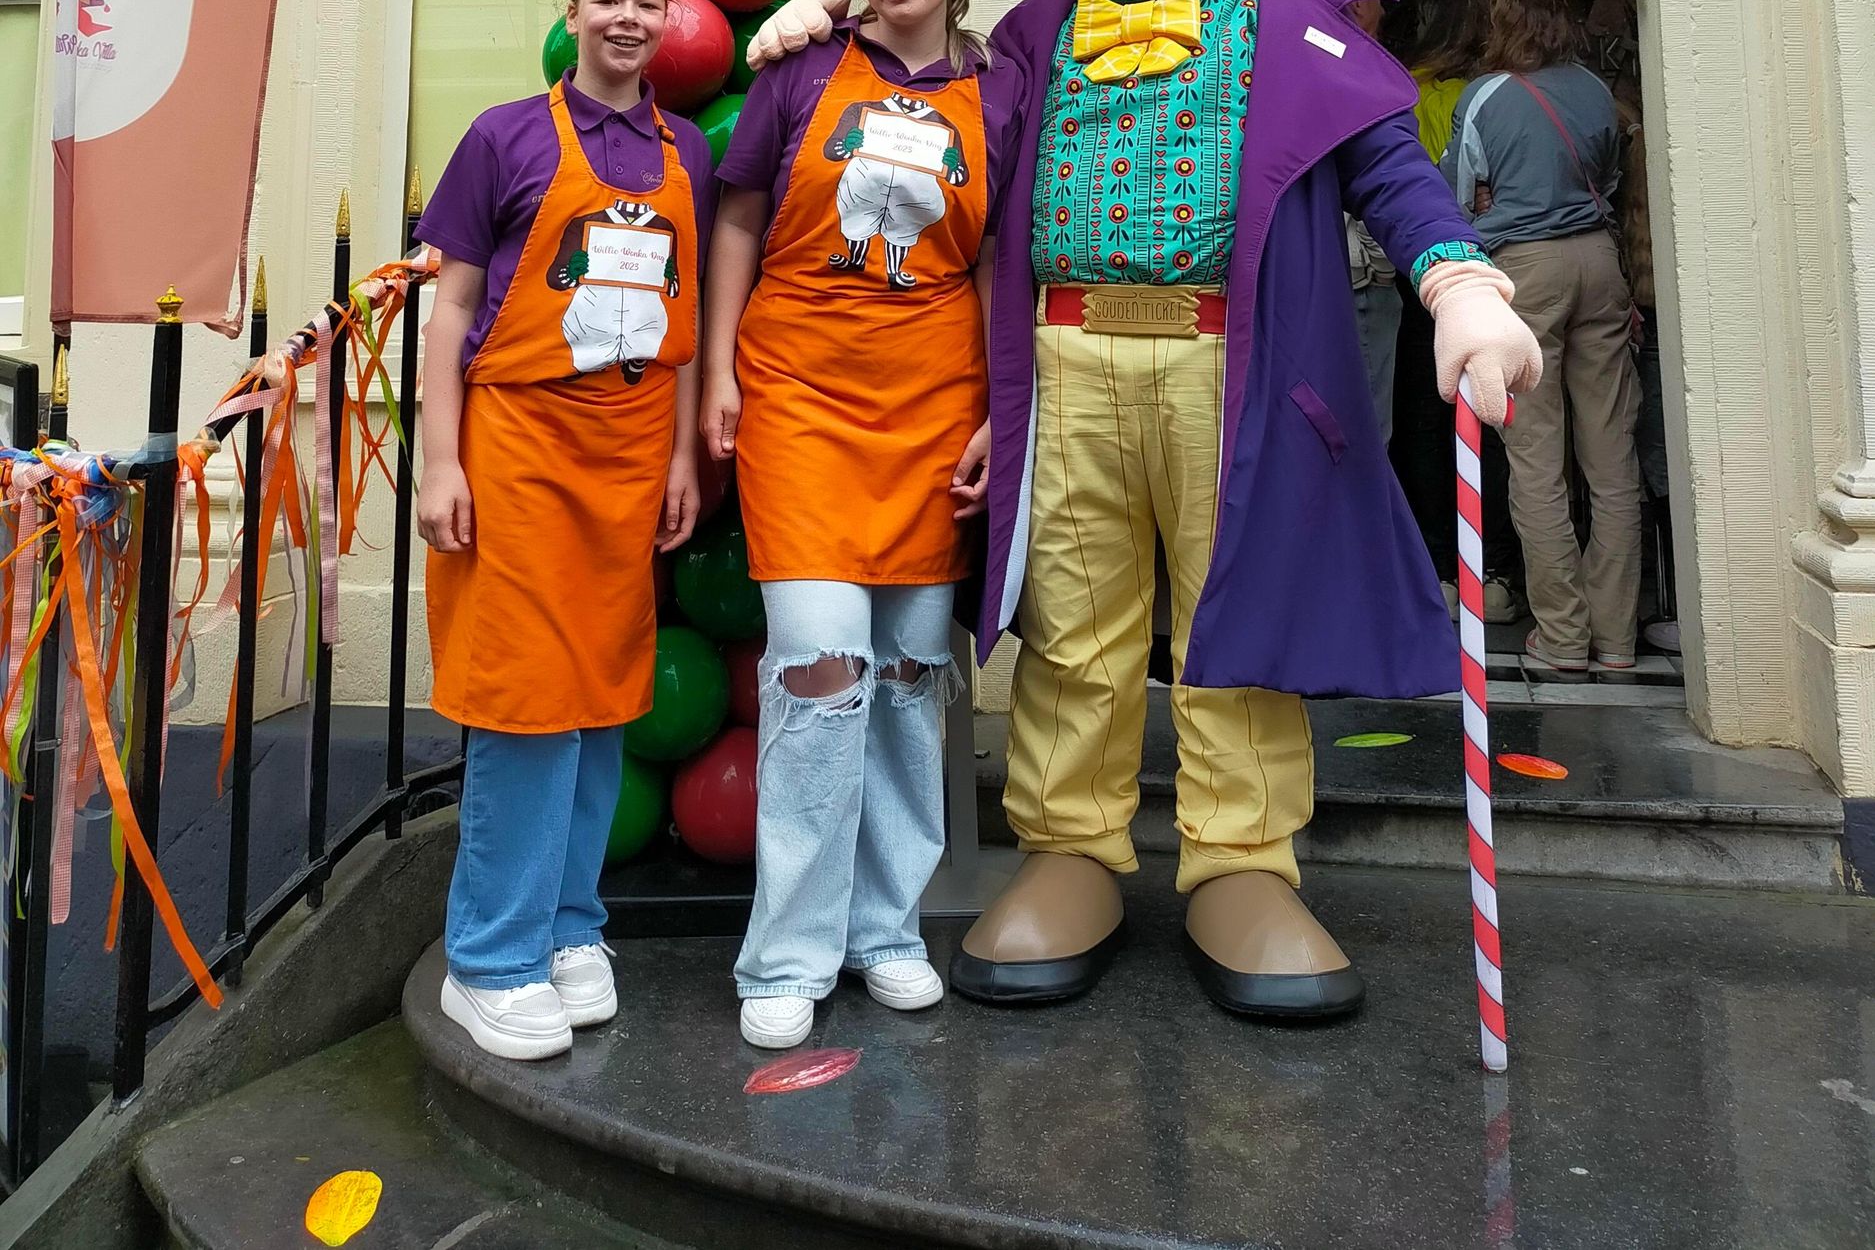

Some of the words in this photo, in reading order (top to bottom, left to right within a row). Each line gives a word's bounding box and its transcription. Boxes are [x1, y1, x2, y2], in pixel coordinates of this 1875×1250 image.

[591, 244, 619, 255] Willie
[620, 246, 648, 259] Wonka
[649, 251, 666, 264] Day
[619, 260, 640, 271] 2023
[1141, 301, 1184, 323] TICKET
